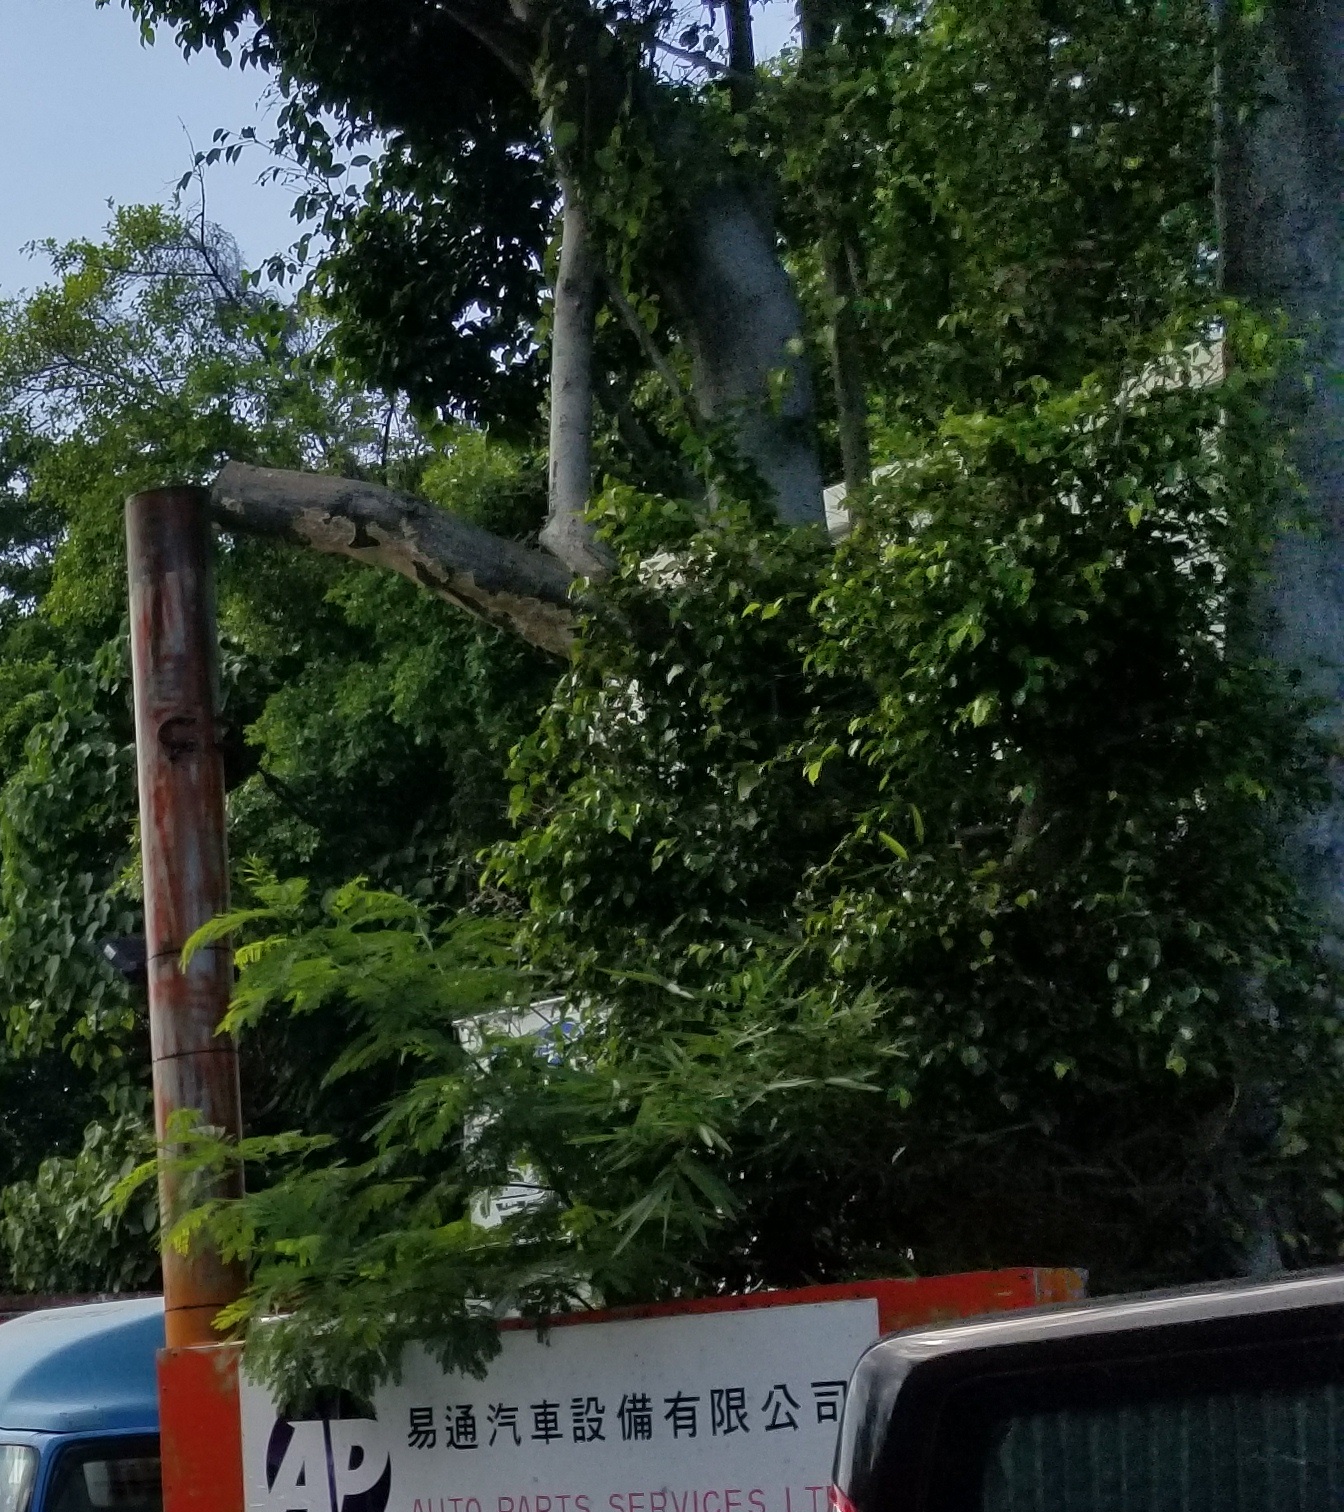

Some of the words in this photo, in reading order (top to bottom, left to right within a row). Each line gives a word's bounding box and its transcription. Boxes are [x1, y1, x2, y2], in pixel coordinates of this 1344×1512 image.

[406, 1380, 848, 1450] 易通汽車設備有限公司
